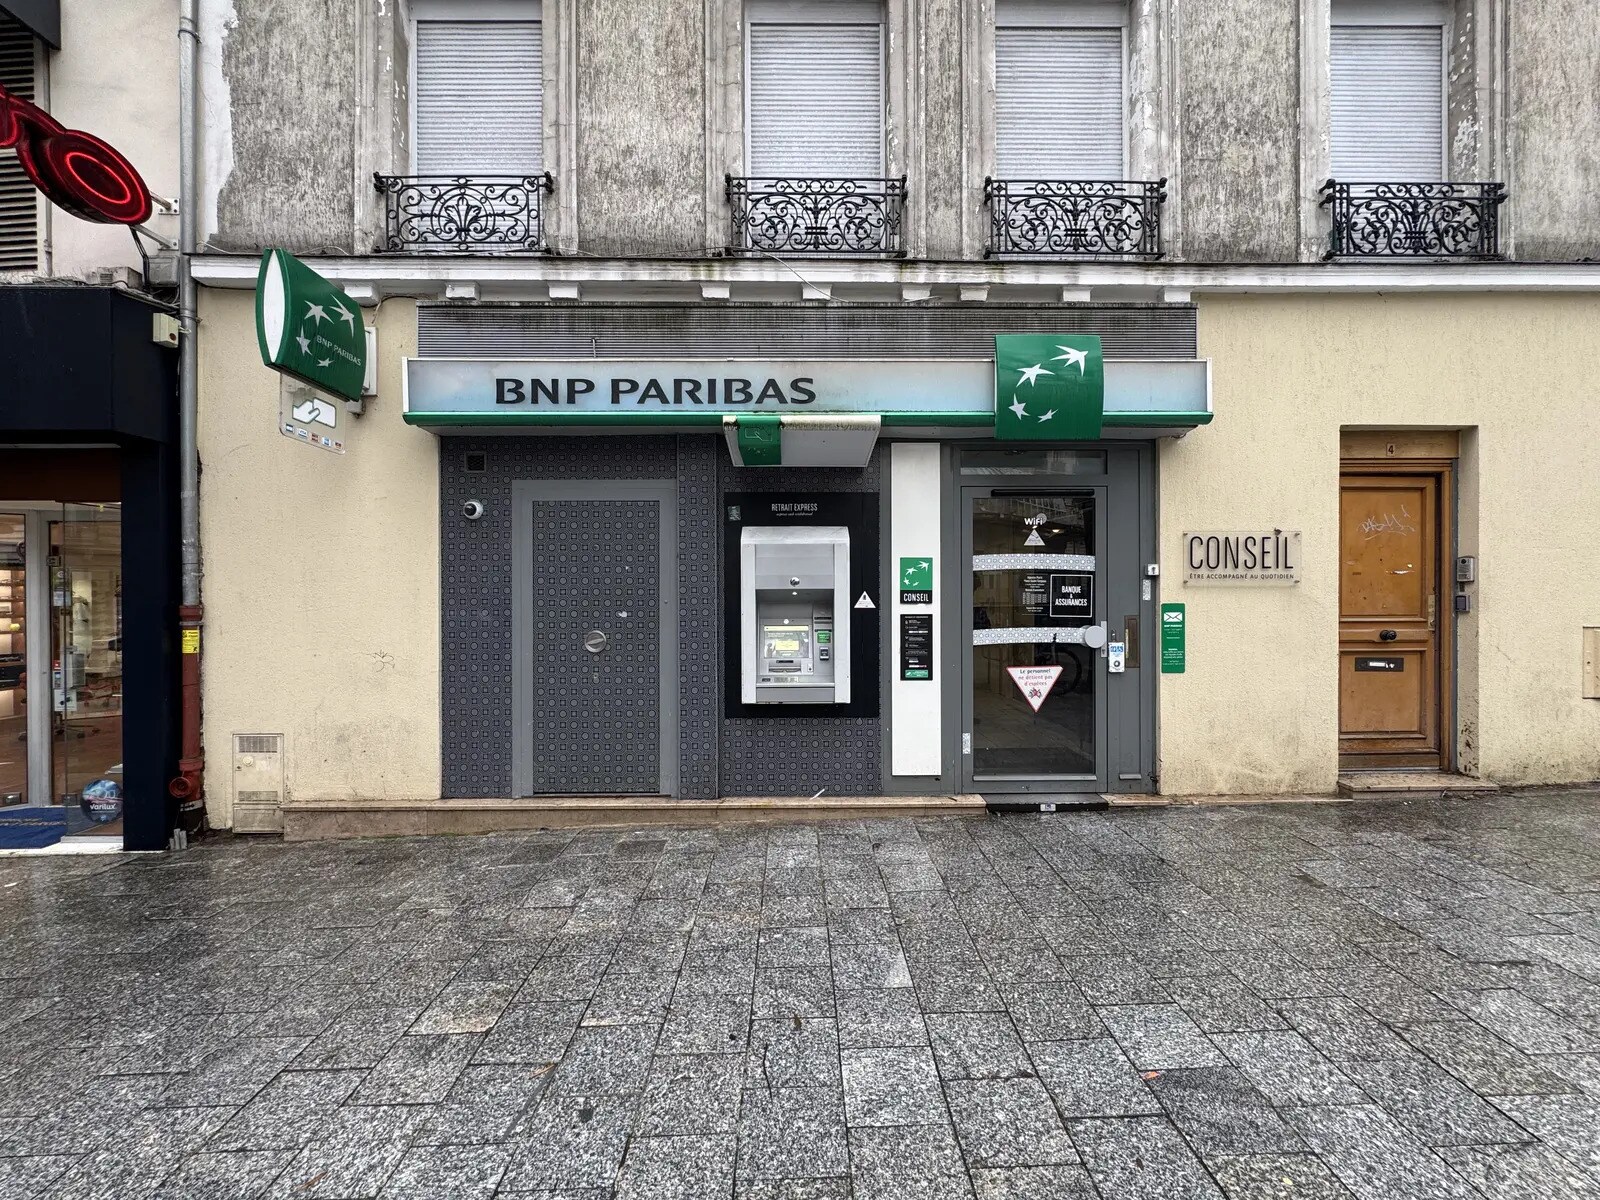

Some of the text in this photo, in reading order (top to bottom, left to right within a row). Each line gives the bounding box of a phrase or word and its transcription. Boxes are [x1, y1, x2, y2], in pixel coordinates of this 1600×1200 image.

[316, 335, 361, 366] BNP PARIBAS
[495, 377, 816, 405] BNP PARIBAS
[1388, 445, 1395, 454] 4
[771, 503, 818, 512] RETRAIT EXPRESS
[1024, 517, 1043, 525] WiFi
[1190, 536, 1294, 569] CONSEIL
[1061, 586, 1082, 594] BANQUE
[903, 593, 929, 601] CONSEIL
[1054, 598, 1088, 606] ASSURANCES
